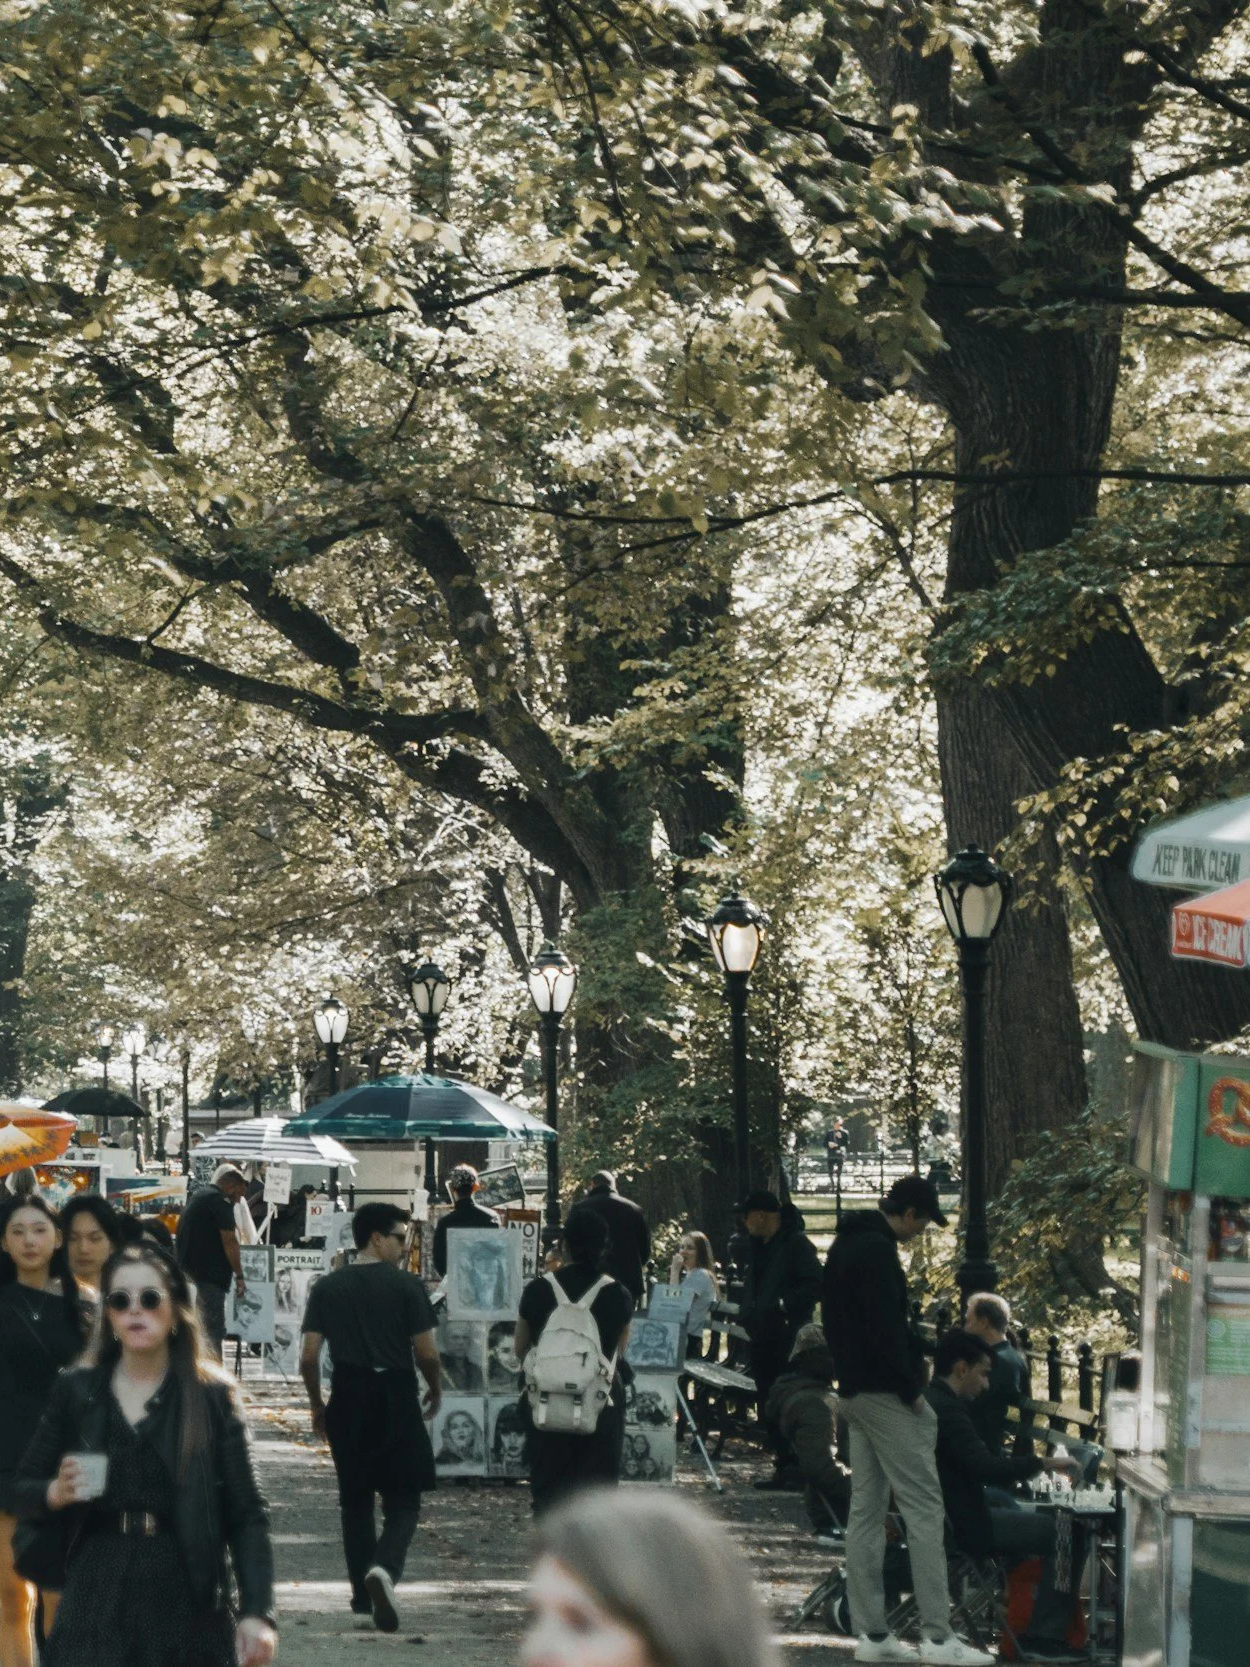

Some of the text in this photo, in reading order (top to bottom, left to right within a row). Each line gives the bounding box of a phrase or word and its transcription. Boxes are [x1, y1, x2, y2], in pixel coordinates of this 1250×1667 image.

[1152, 844, 1241, 884] KEEP PARK CLEAN
[277, 1255, 321, 1264] PORTRAIT
